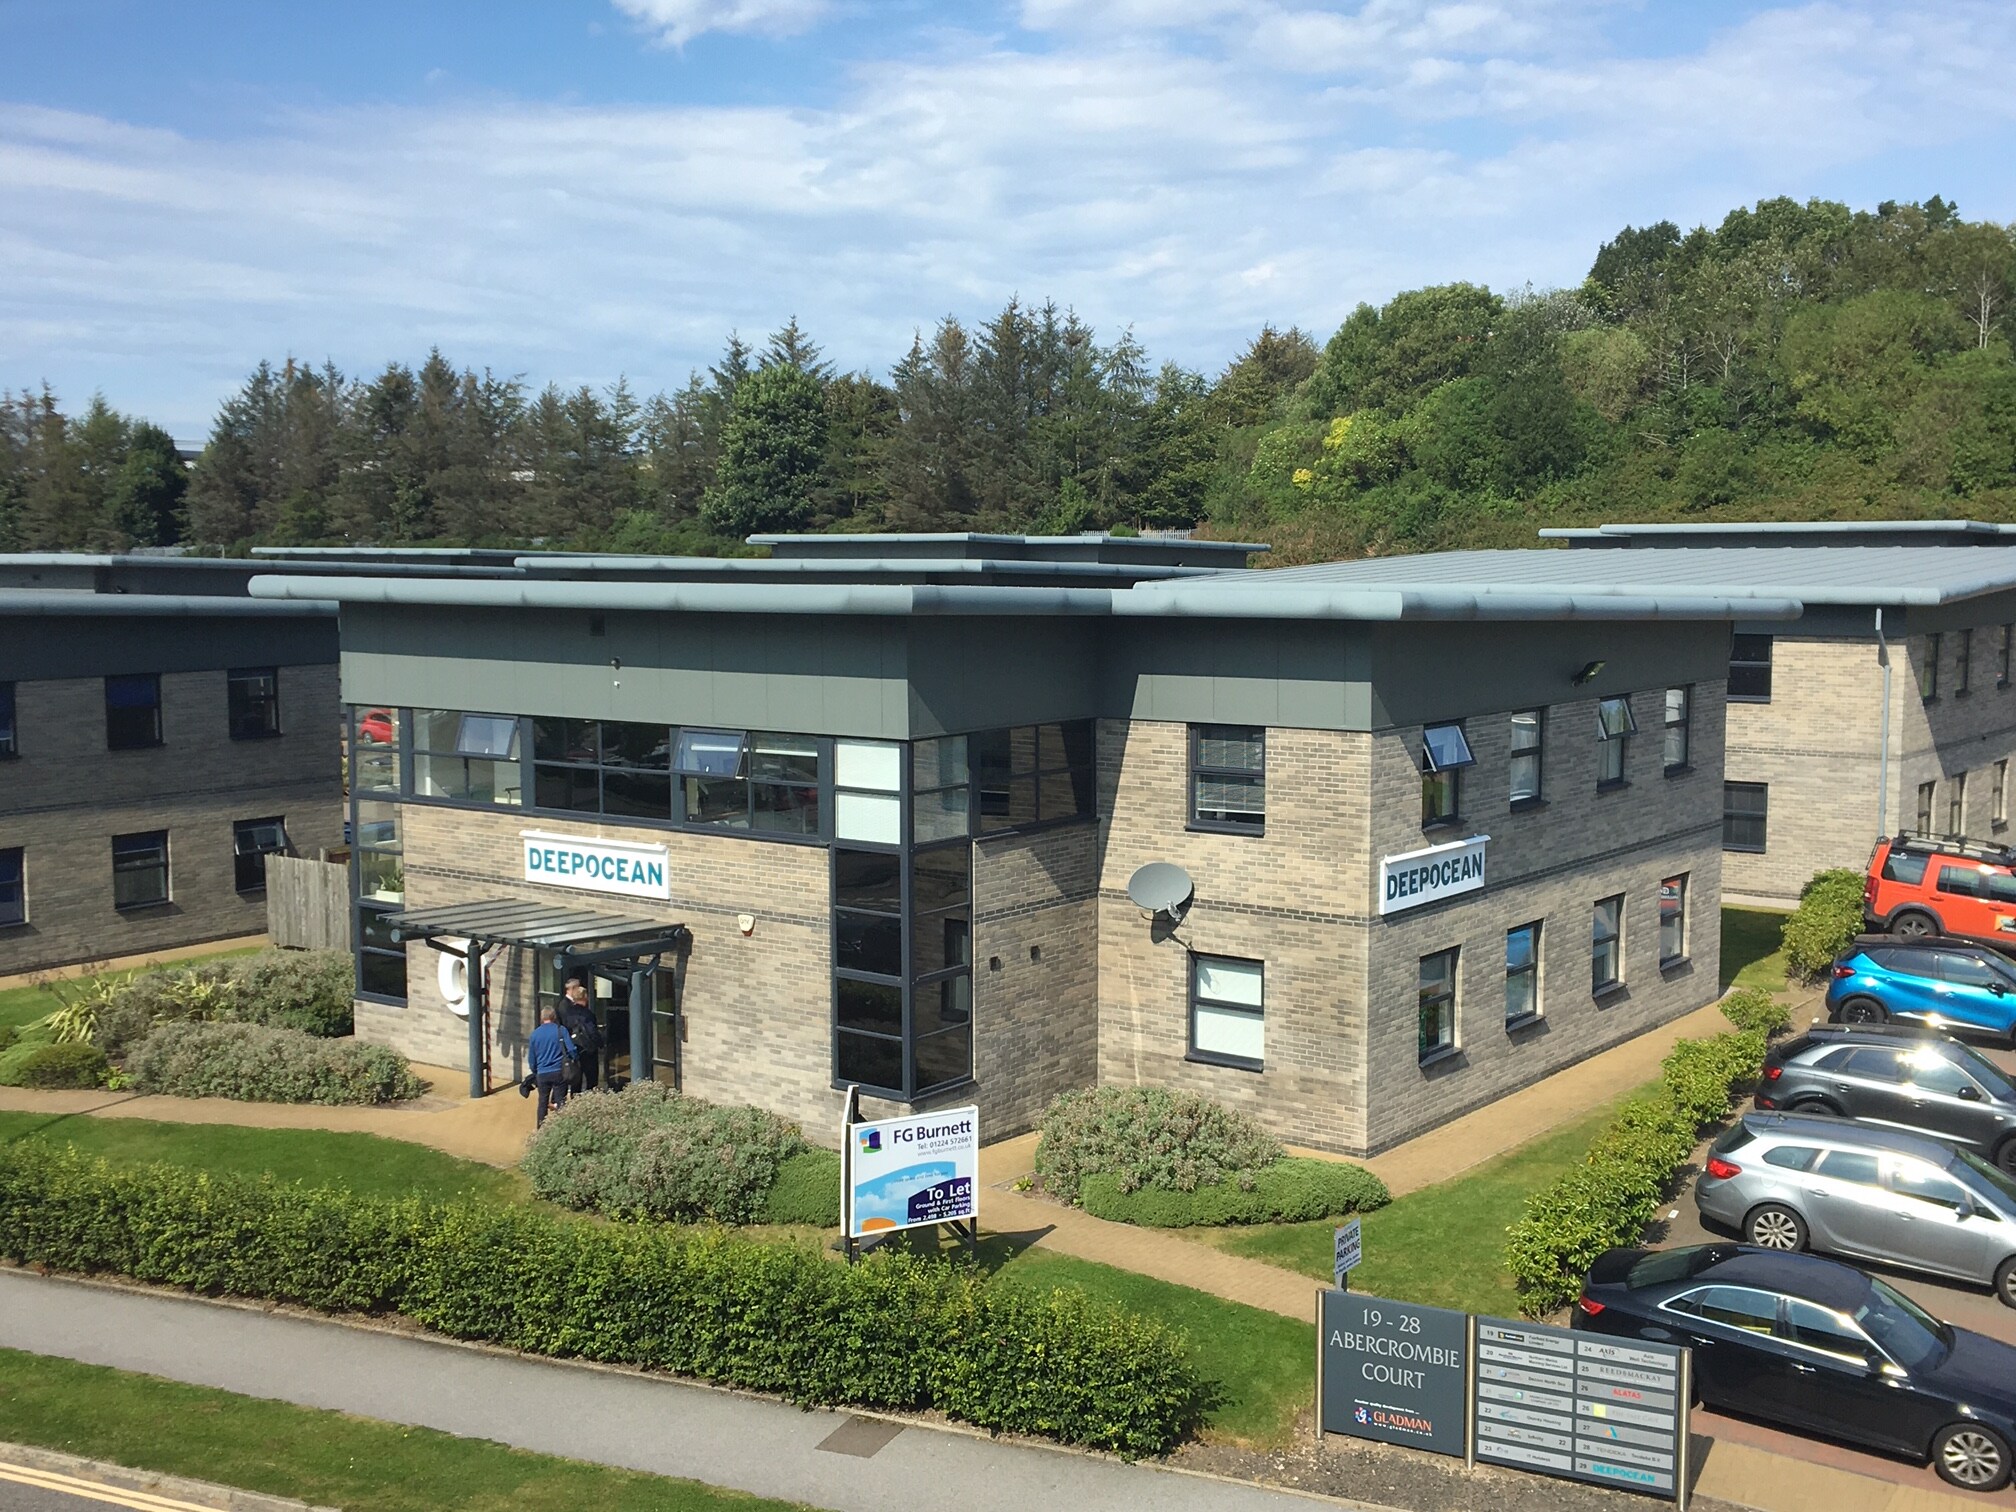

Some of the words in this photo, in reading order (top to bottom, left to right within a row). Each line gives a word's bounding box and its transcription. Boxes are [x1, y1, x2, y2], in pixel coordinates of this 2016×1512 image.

[529, 847, 663, 887] DEEPOCEAN
[1387, 852, 1482, 900] DEEPOCEAN
[894, 1128, 913, 1144] FG
[916, 1120, 971, 1140] Burnett
[929, 1139, 948, 1148] 01224
[950, 1136, 972, 1146] 572661
[927, 1188, 944, 1200] To
[949, 1182, 970, 1197] Let
[916, 1201, 935, 1209] Ground
[1337, 1238, 1360, 1262] PARKING
[1363, 1308, 1382, 1327] 19
[1399, 1315, 1421, 1334] 28
[1330, 1330, 1460, 1368] ABERCROMBIE
[1362, 1362, 1425, 1389] COURT
[1373, 1411, 1432, 1432] GLADMAN
[1592, 1464, 1655, 1483] DEEPOCEAN
